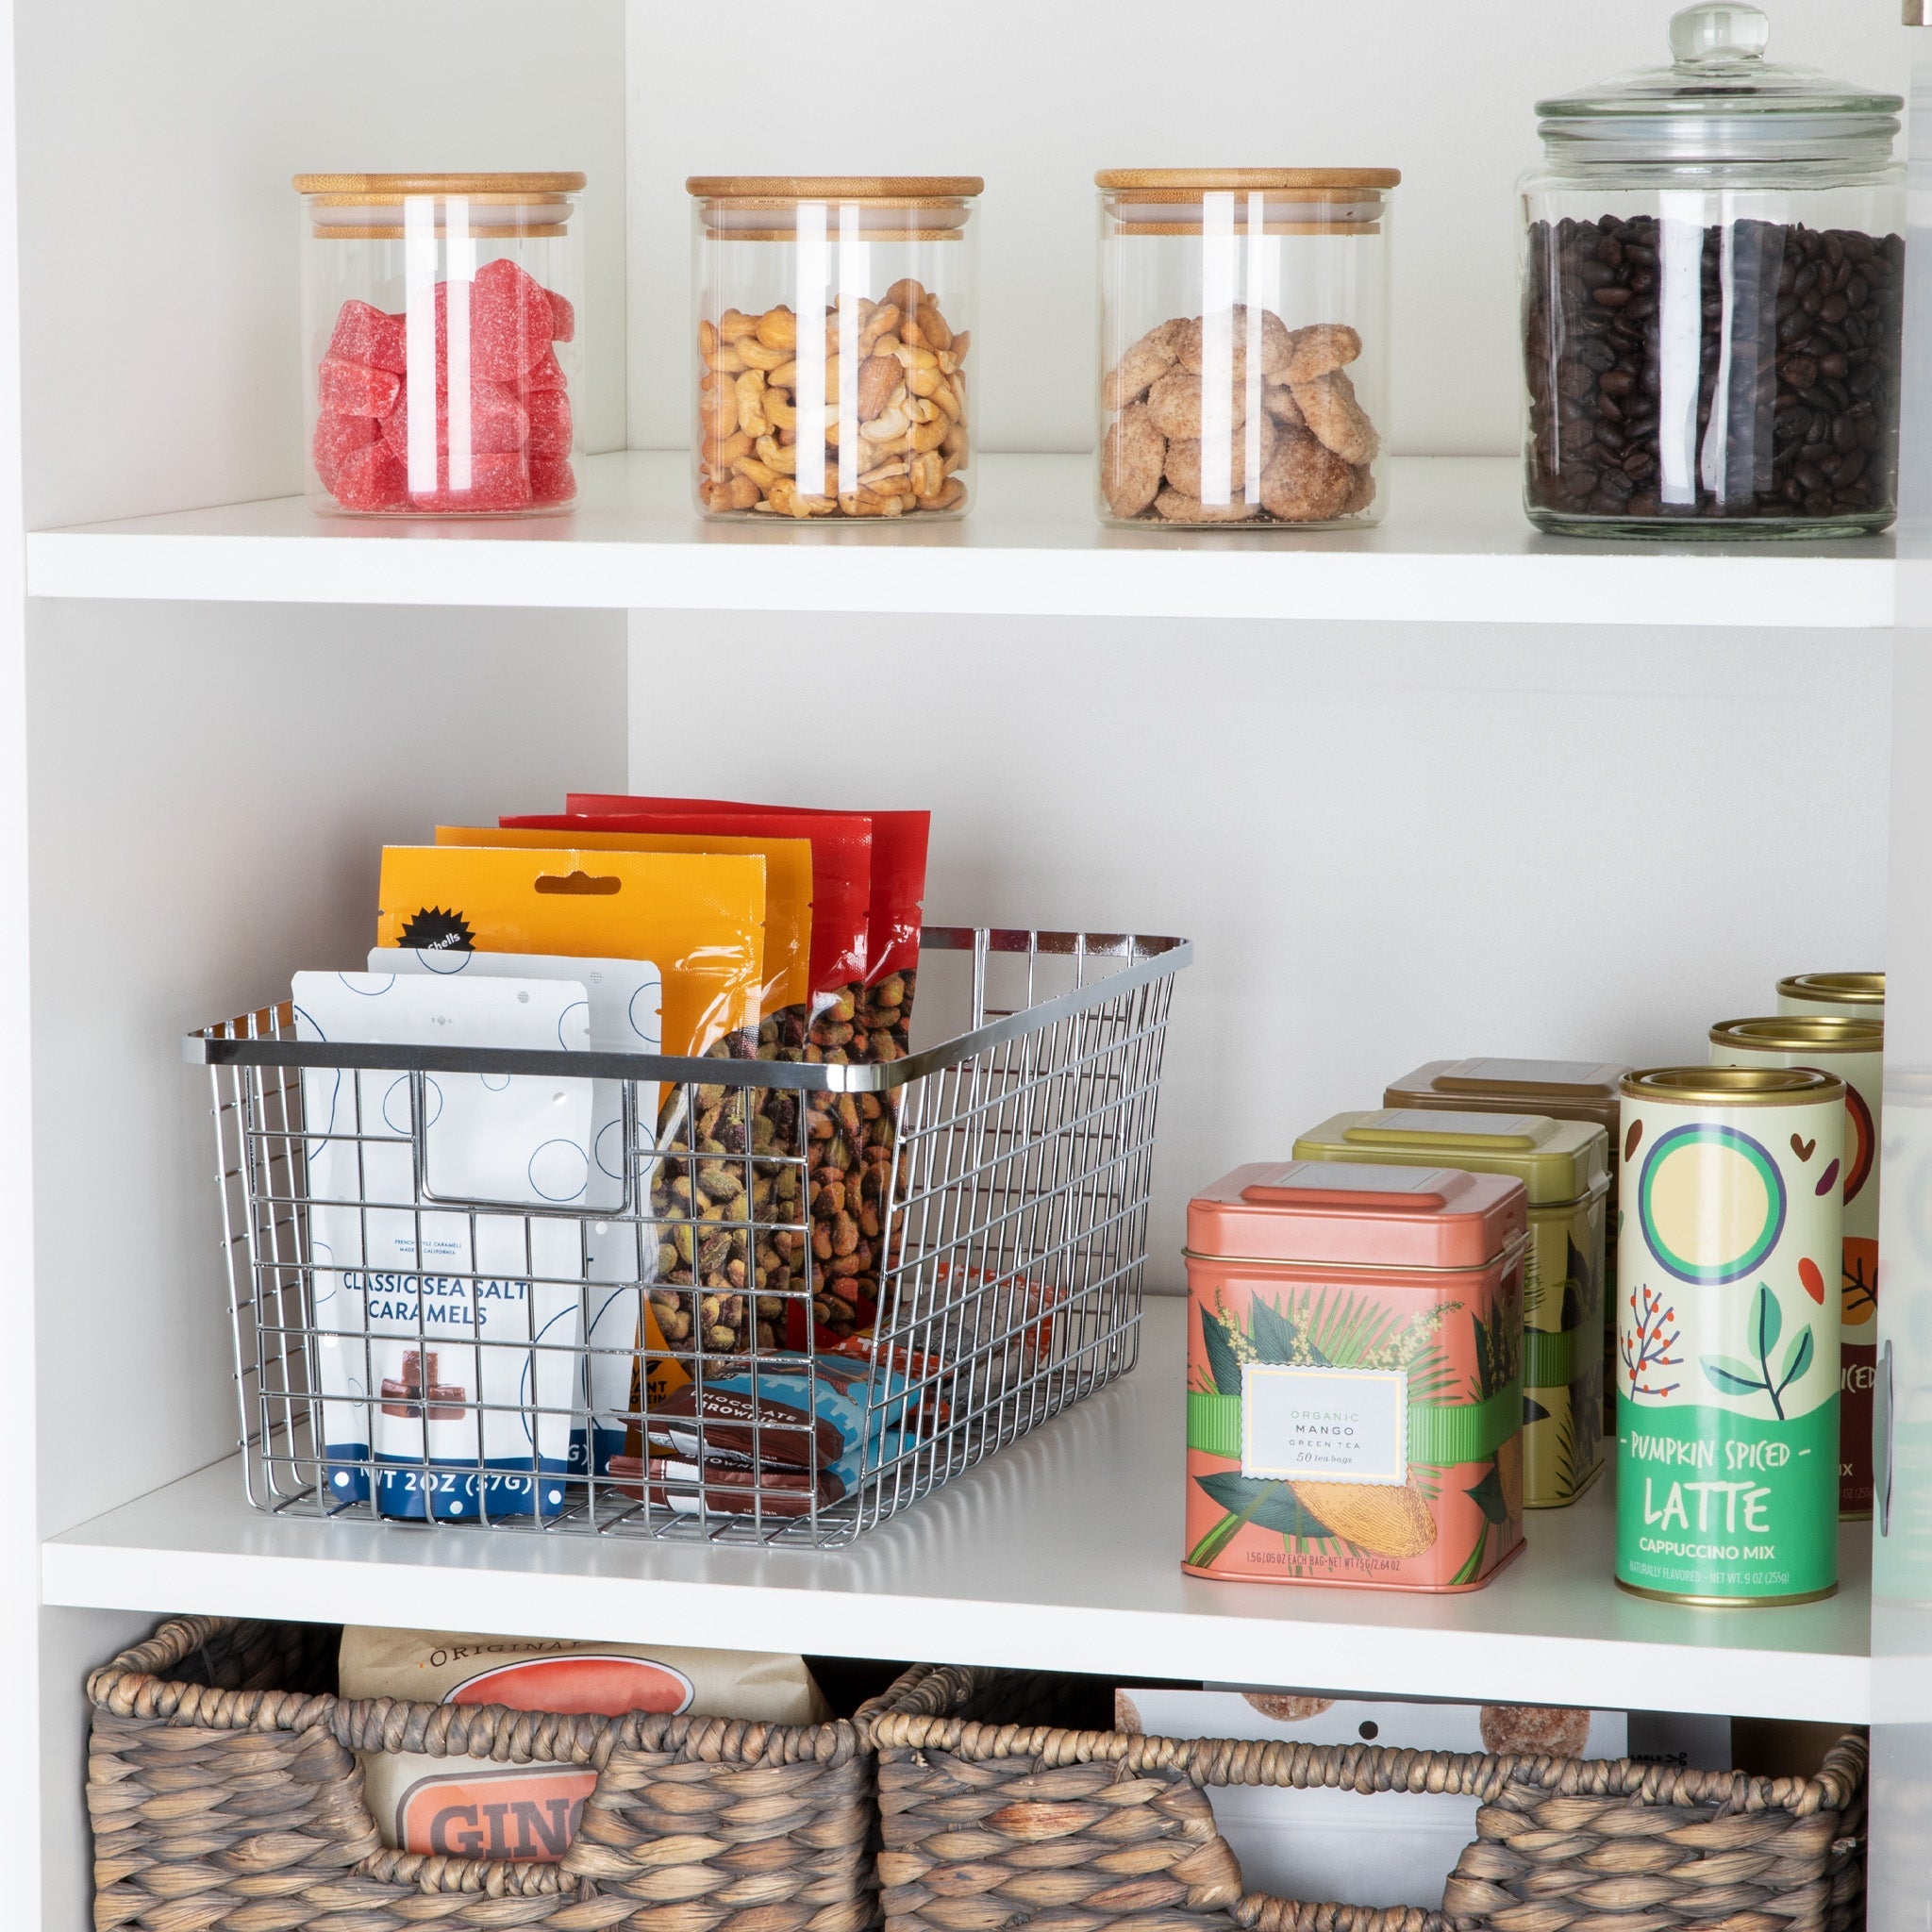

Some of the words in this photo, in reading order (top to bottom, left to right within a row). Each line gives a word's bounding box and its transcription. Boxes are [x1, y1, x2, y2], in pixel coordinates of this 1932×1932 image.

[343, 1272, 418, 1294] CLASSIC
[422, 1276, 466, 1297] SEA
[475, 1279, 528, 1300] SALT
[368, 1299, 488, 1325] CARAMELS
[1291, 1409, 1359, 1423] ORGANIC
[1295, 1424, 1355, 1436] MANGO
[1289, 1439, 1331, 1448] GREEN
[1631, 1430, 1715, 1469] PUMPKIN
[1724, 1439, 1790, 1472] SPICED
[1296, 1452, 1312, 1462] 50
[1314, 1454, 1328, 1462] tea
[1331, 1455, 1353, 1464] bags
[1644, 1477, 1772, 1533] LATTE
[1639, 1537, 1740, 1560] CAPPUCCINO
[1743, 1545, 1775, 1560] MIX
[1276, 1553, 1286, 1564] OZ
[1287, 1554, 1307, 1565] EACH
[1344, 1557, 1354, 1568] WT
[1391, 1559, 1401, 1571] OZ
[1629, 1559, 1661, 1578] NATURALLY
[1662, 1567, 1702, 1583] FLAVORED
[1710, 1572, 1726, 1584] NET
[1745, 1572, 1751, 1584] 9
[1752, 1573, 1763, 1584] OZ
[1764, 1572, 1790, 1585] (255g)
